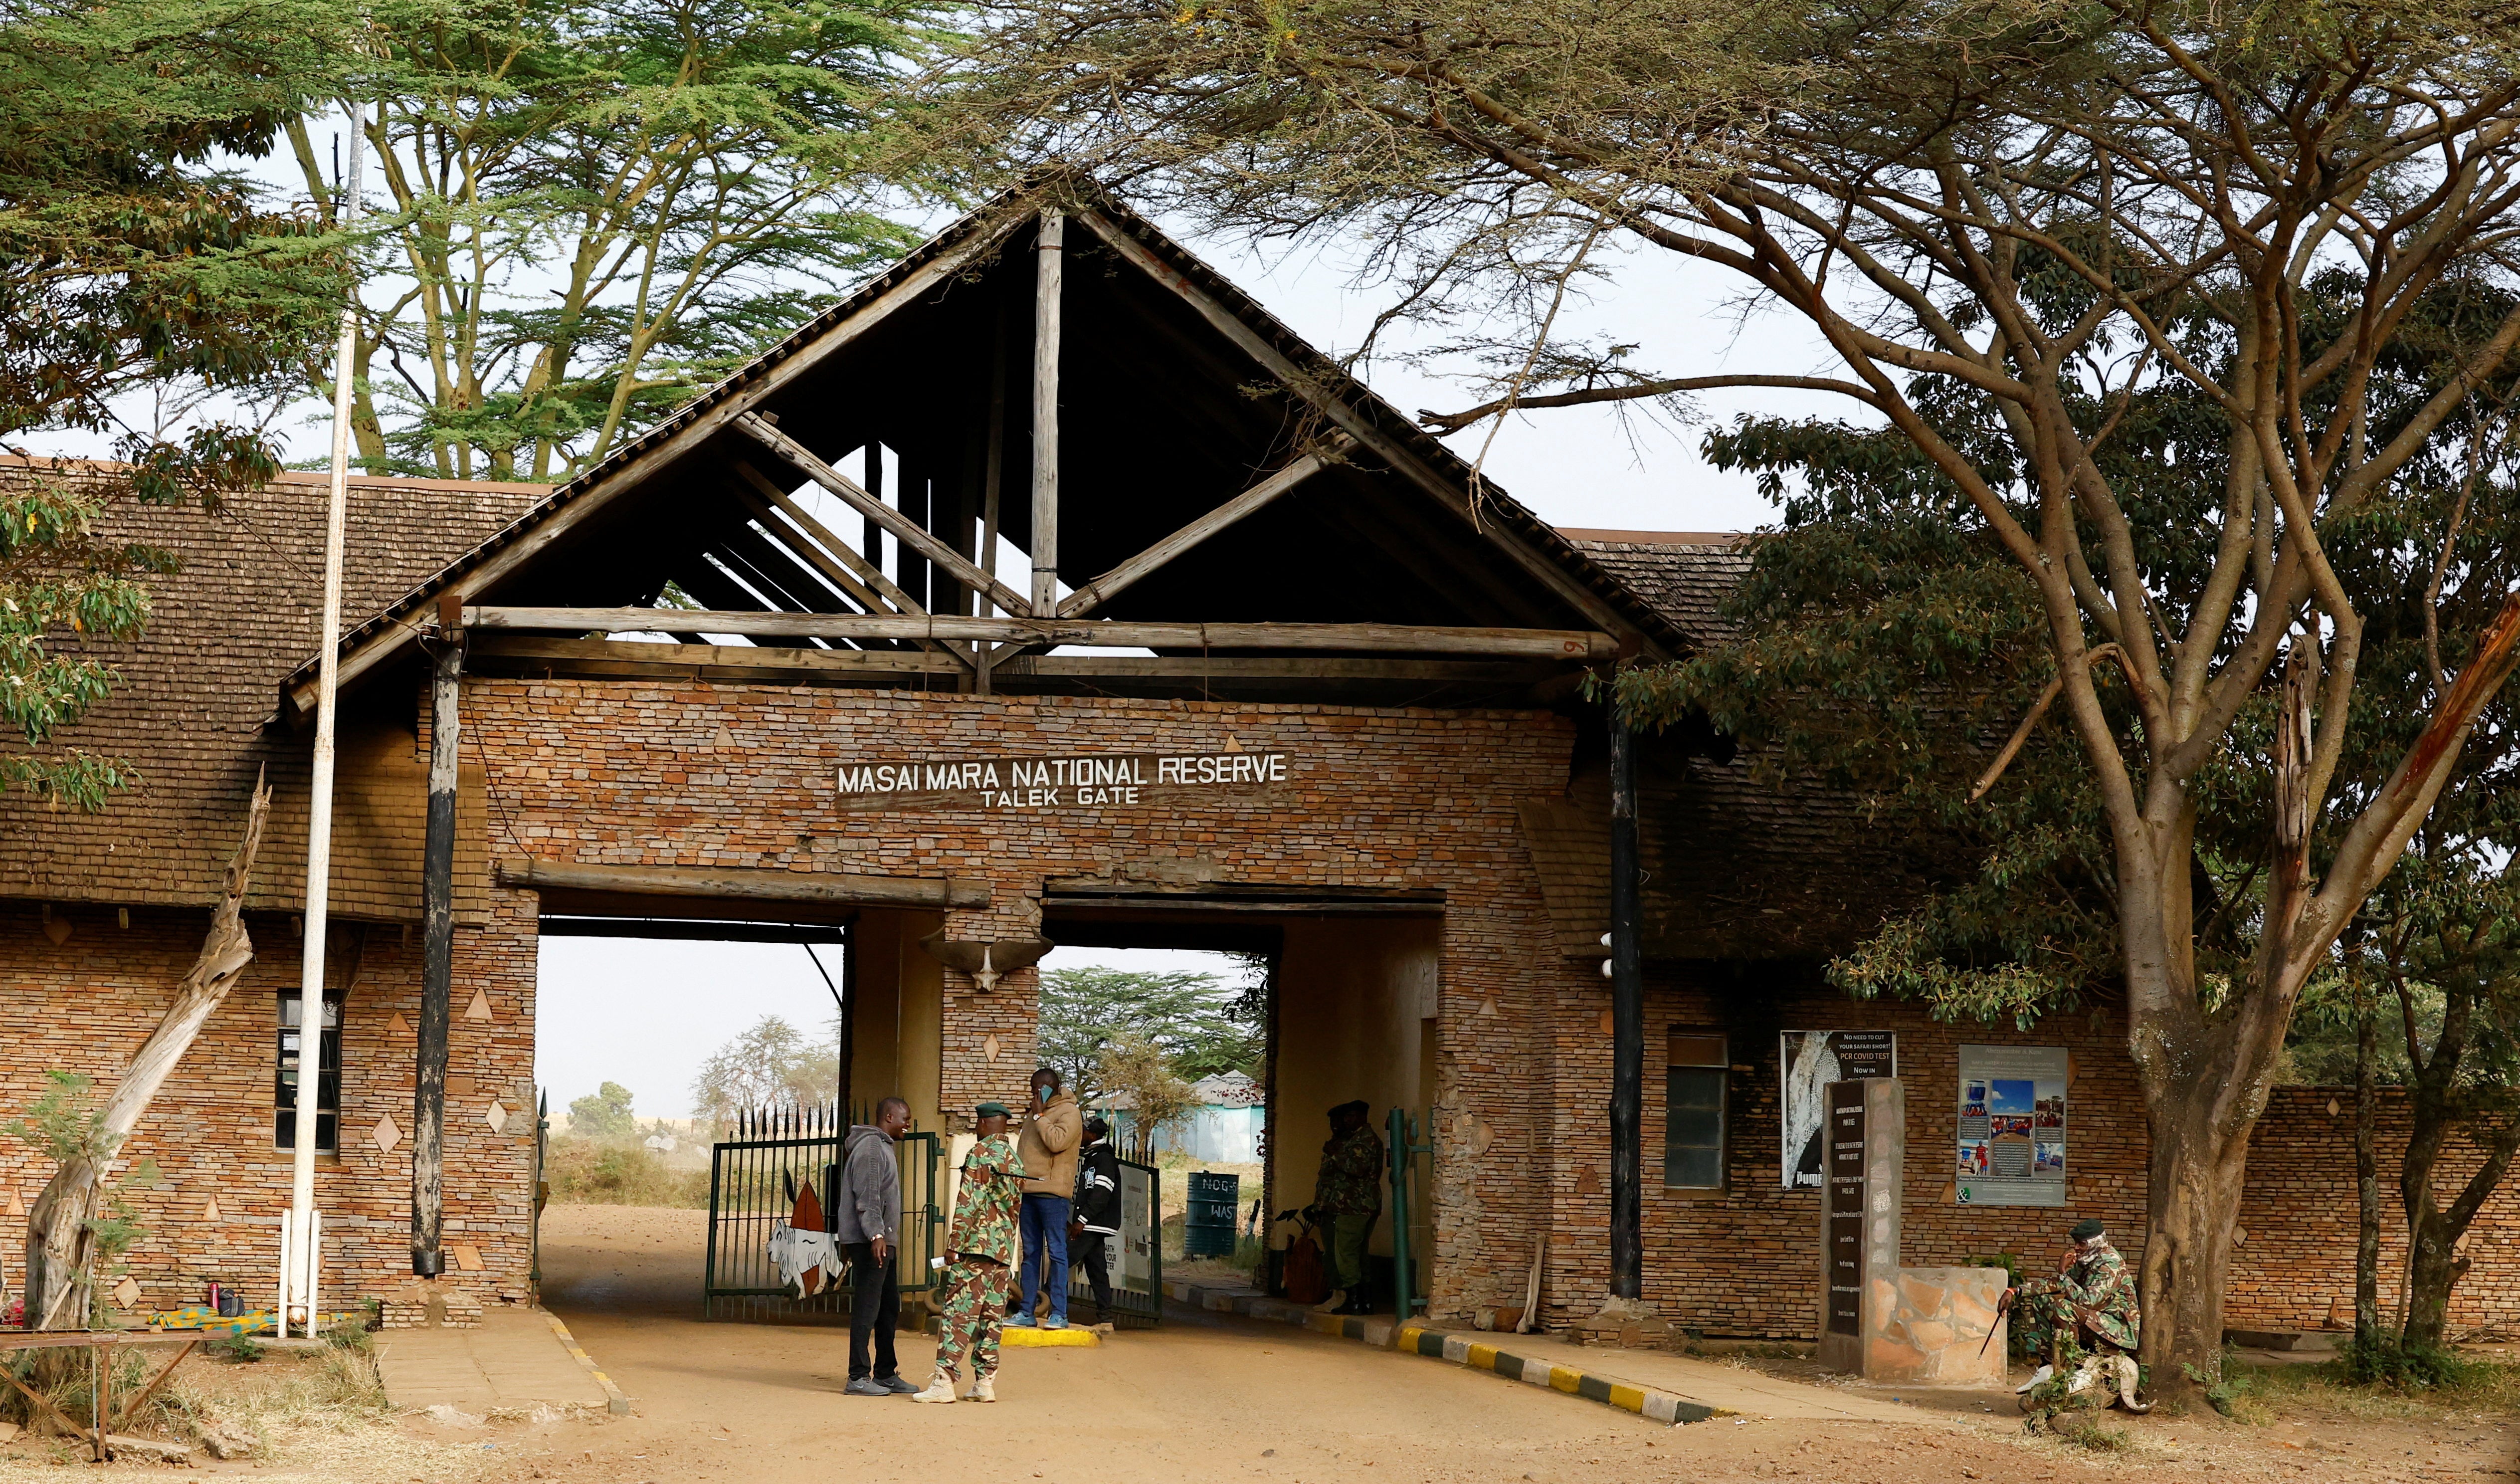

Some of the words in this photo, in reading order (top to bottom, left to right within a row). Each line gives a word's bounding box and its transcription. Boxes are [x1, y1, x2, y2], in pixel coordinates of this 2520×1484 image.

[839, 765, 918, 793] MASAI
[927, 764, 999, 790] MARA
[1012, 759, 1148, 787] NATIONAL
[1159, 754, 1287, 784] RESERVE
[979, 788, 1059, 808] TALEK
[1077, 787, 1139, 805] GATE
[1105, 1245, 1115, 1253] ARTH
